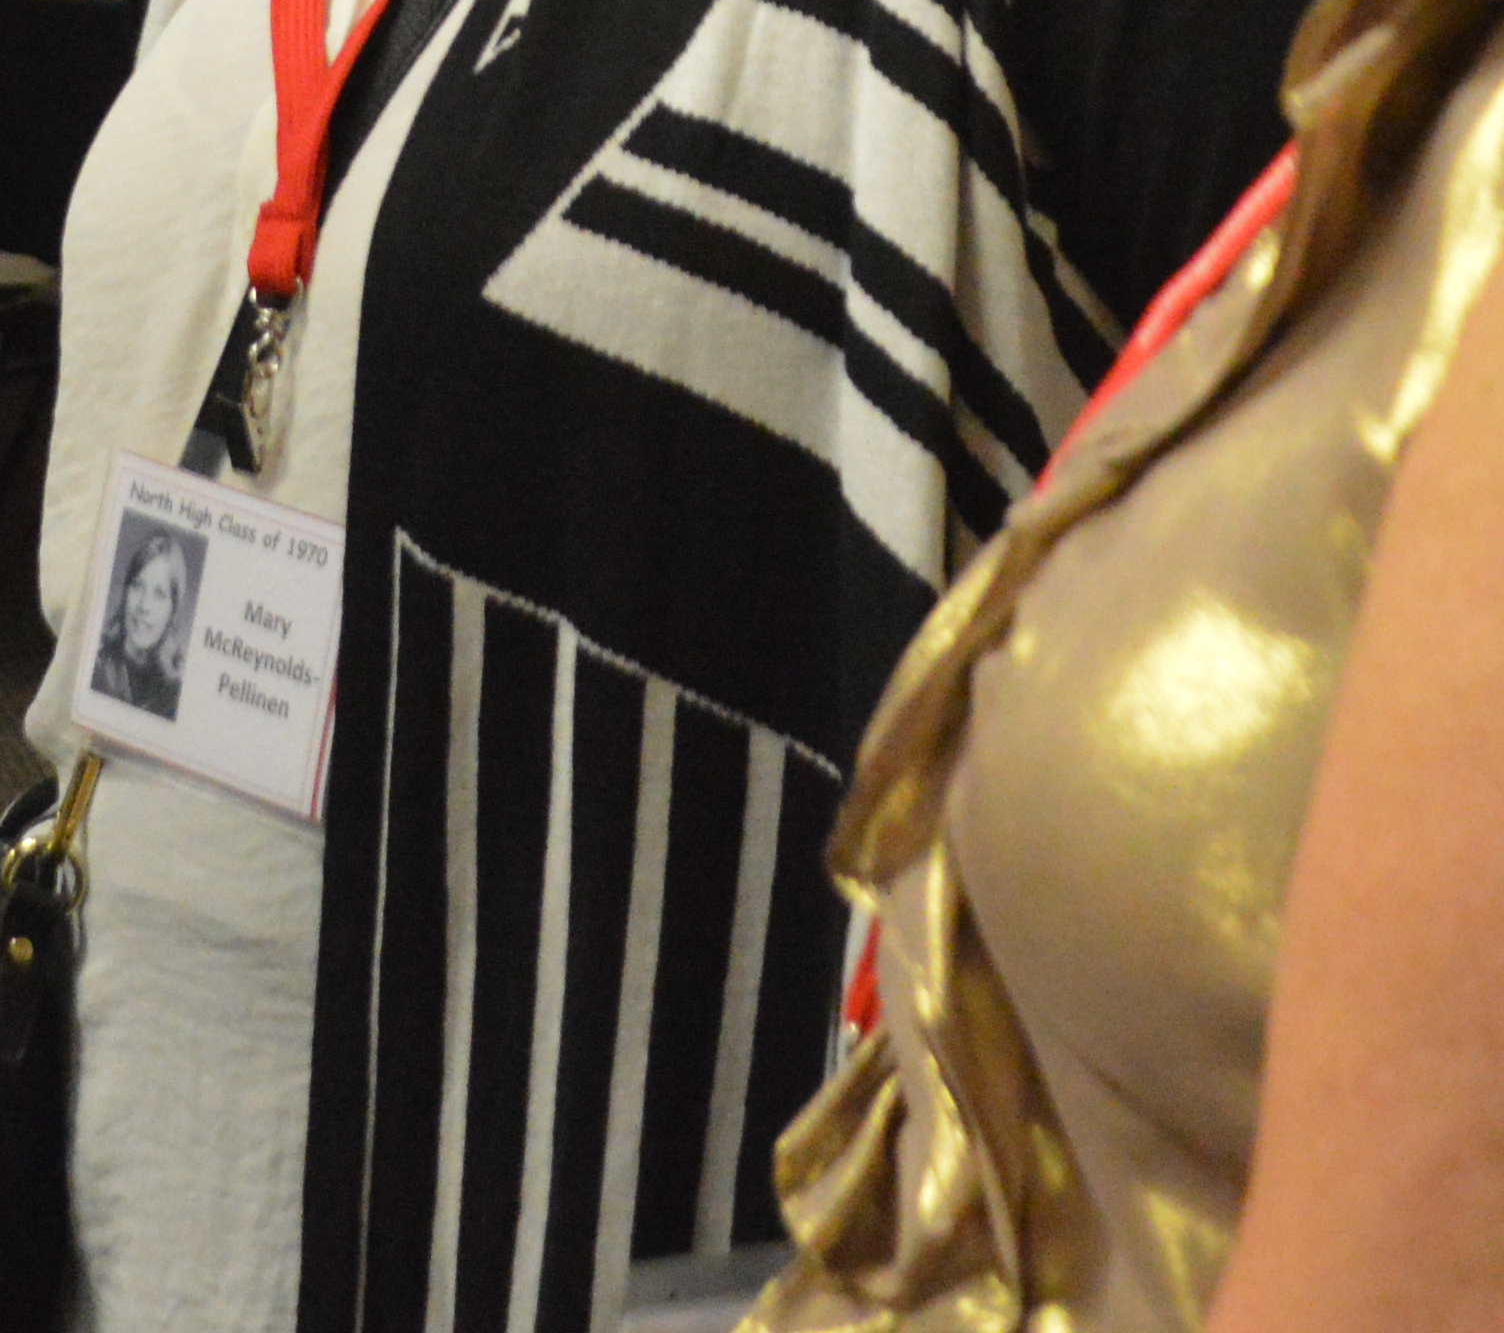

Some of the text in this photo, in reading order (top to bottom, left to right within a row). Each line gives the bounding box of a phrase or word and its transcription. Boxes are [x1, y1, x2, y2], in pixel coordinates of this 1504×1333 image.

[129, 480, 329, 568] North High Class of 1970
[244, 600, 293, 641] Mary
[203, 626, 321, 687] McReynolds-
[218, 673, 291, 719] Pellinen
